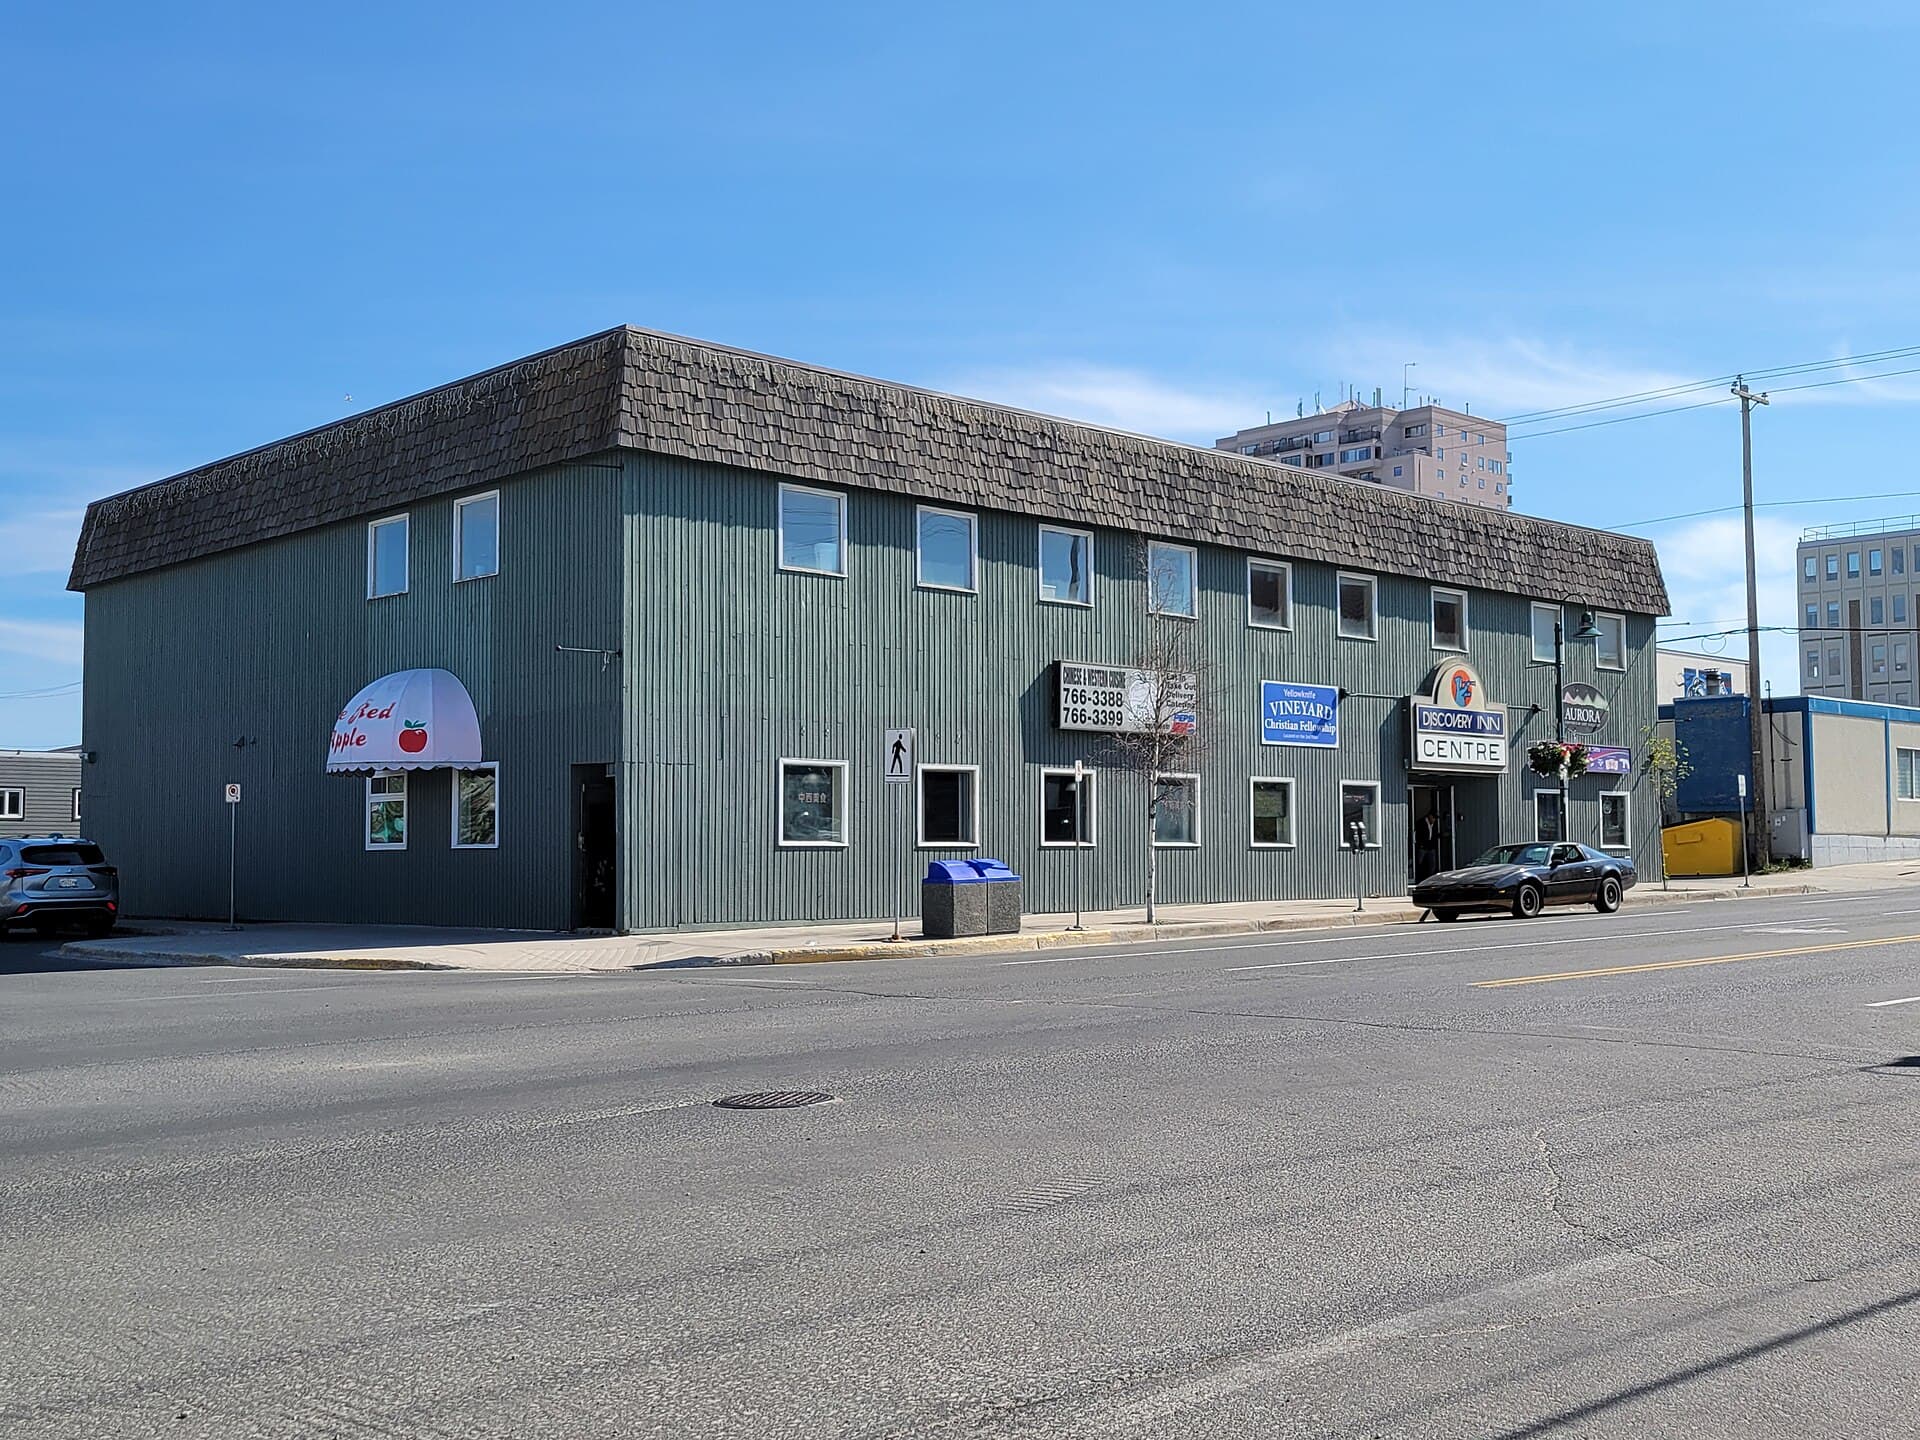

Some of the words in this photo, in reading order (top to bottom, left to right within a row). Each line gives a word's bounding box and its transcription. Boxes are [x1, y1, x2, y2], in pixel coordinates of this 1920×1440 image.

[1184, 682, 1196, 691] Out
[1283, 688, 1316, 699] Yellowknife
[1063, 688, 1123, 707] 766-3388
[347, 700, 396, 725] Red
[1063, 707, 1123, 727] 766-3399
[1269, 700, 1333, 720] VINEYARD
[1564, 707, 1601, 724] AURORA
[1265, 718, 1298, 731] Christian
[1299, 720, 1336, 736] Fellowship
[1422, 711, 1473, 729] DISCOVERY
[1476, 715, 1501, 732] INN
[1423, 739, 1500, 762] CENTRE
